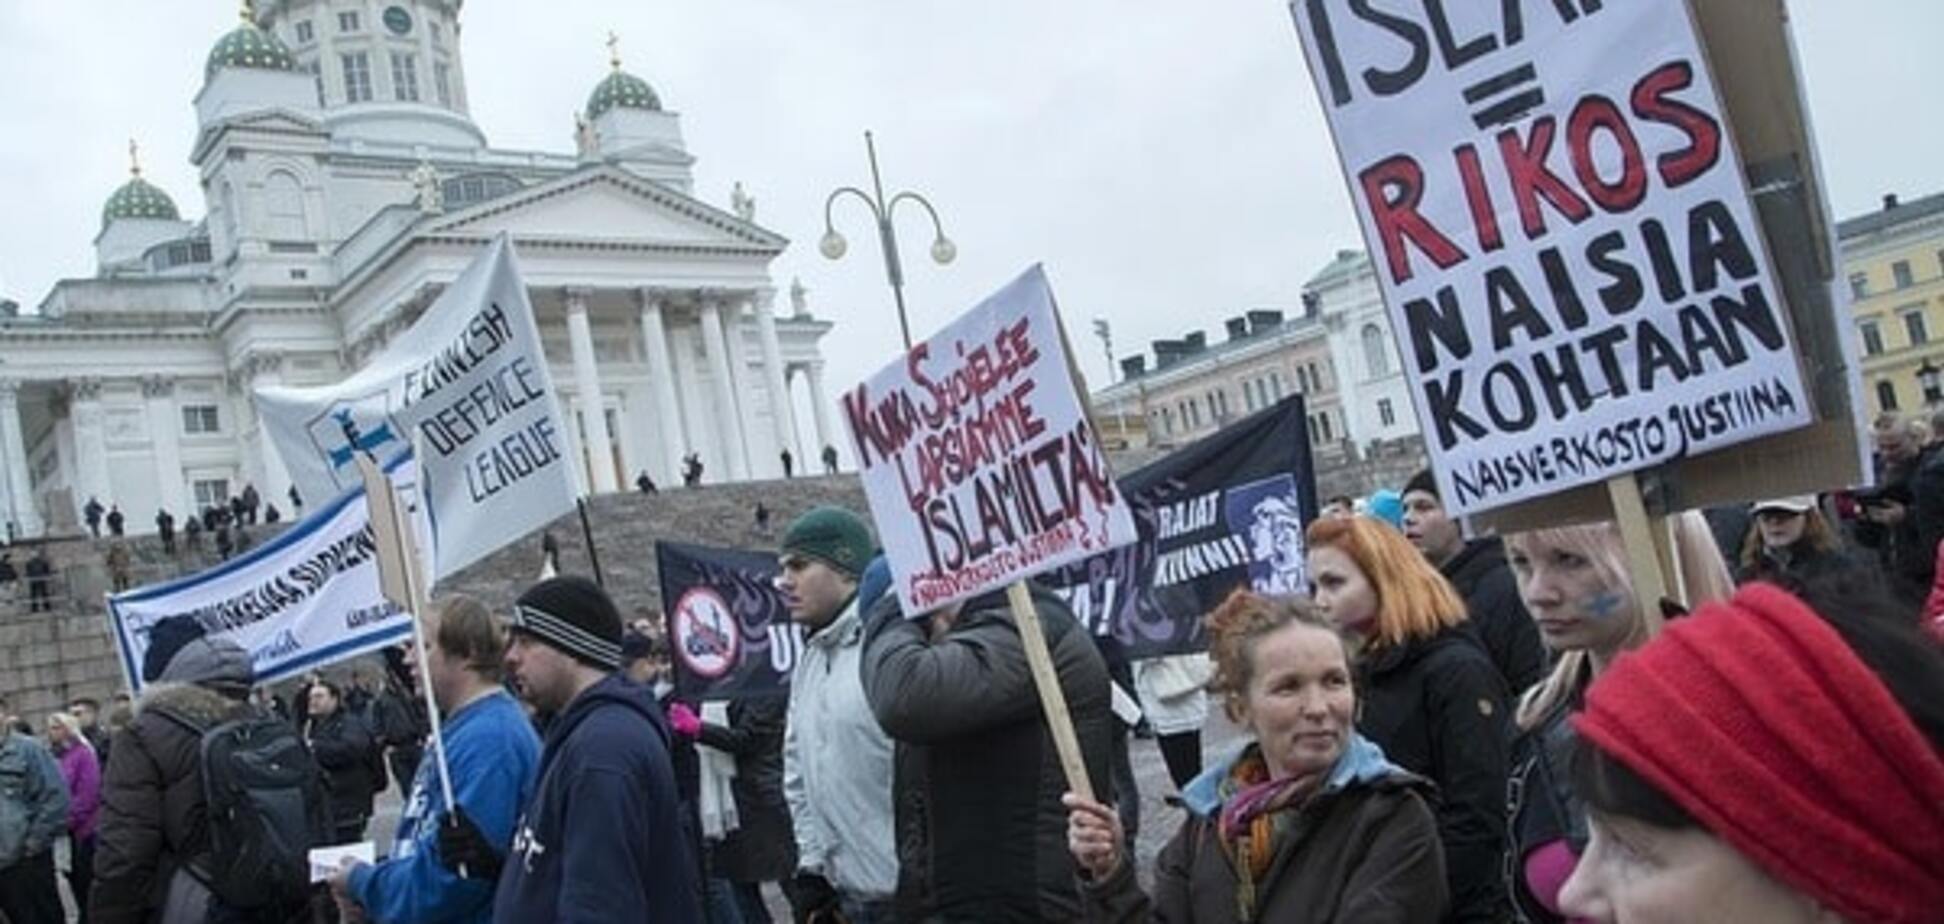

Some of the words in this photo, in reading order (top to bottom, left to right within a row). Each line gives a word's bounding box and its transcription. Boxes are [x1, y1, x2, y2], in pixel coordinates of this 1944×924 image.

[1305, 0, 1603, 107] ISL
[1358, 59, 1722, 286] RIKOS
[1403, 199, 1759, 374] NAISIA
[404, 303, 513, 408] FINNISH
[420, 356, 545, 458] DEFENCE
[1423, 284, 1785, 452] KOHTAAN
[465, 416, 561, 503] LEAGUE
[1451, 415, 1667, 507] NAISVERKOSTO
[1668, 377, 1796, 459] JUSTIINA
[1158, 490, 1220, 540] RAJAT
